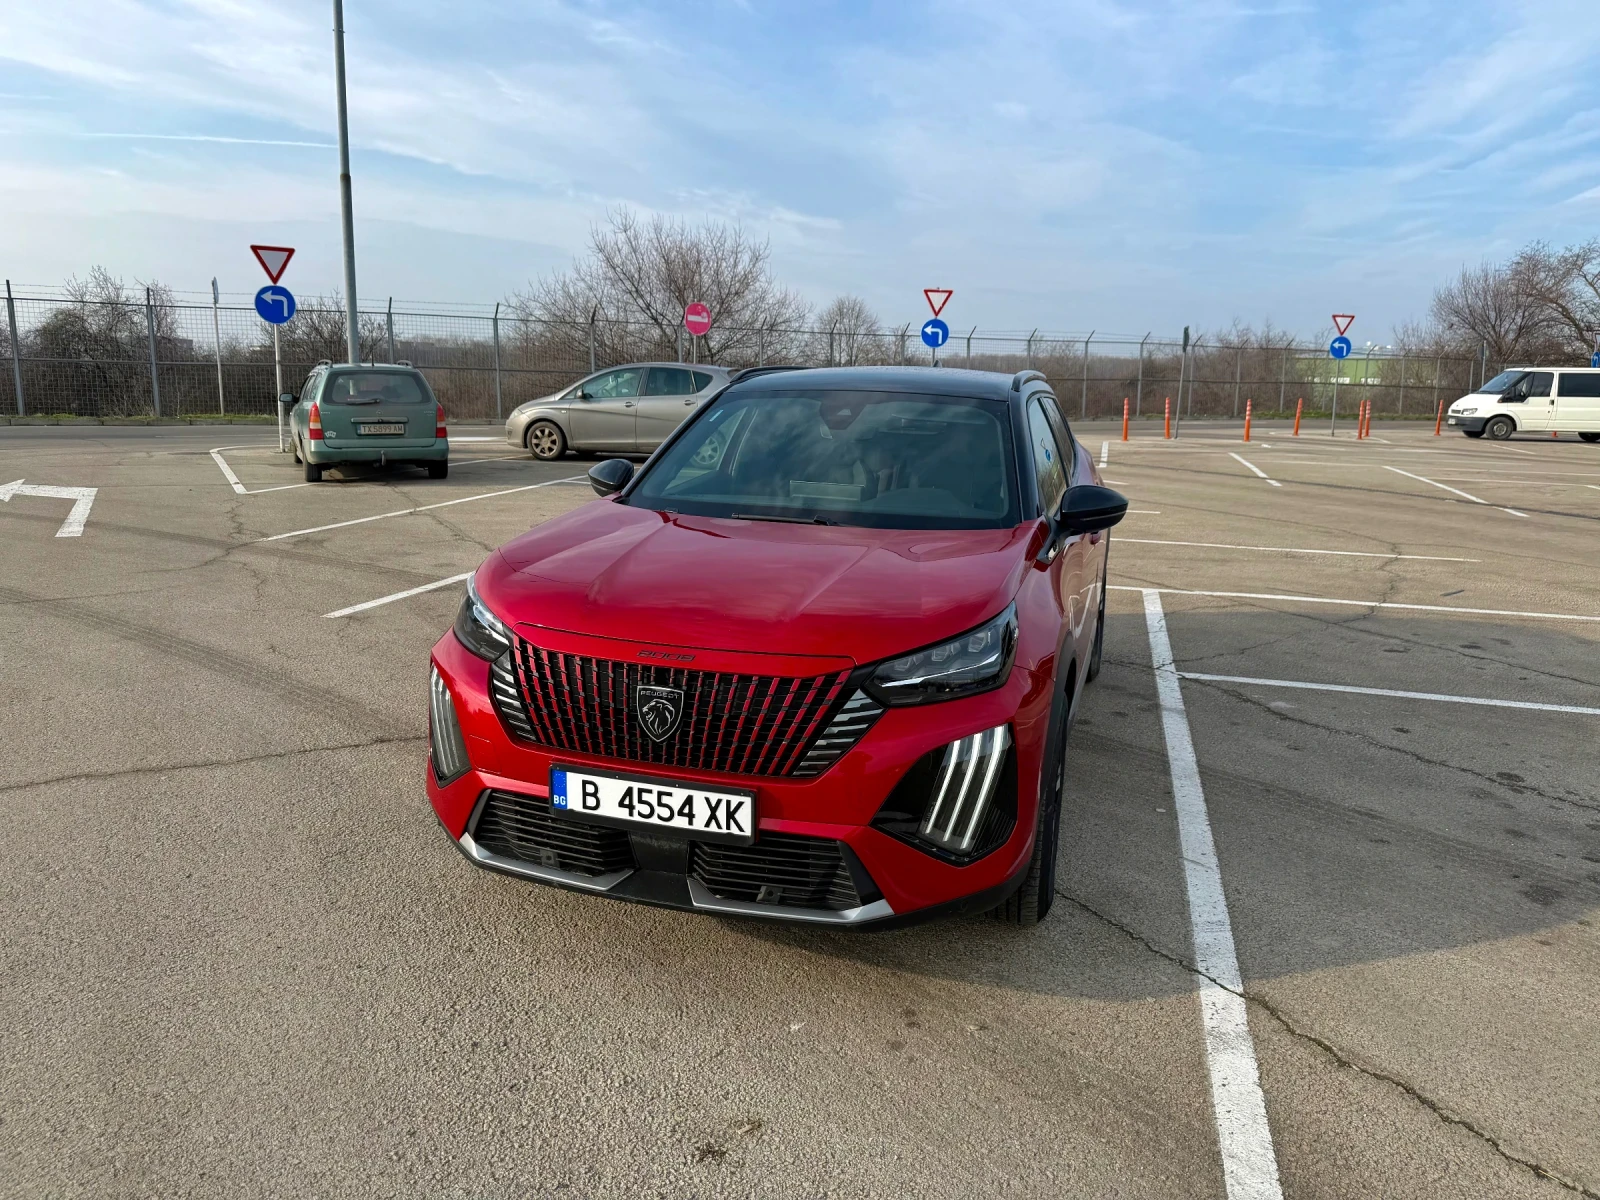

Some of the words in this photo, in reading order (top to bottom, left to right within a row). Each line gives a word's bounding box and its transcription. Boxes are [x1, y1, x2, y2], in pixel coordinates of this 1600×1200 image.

[637, 649, 696, 662] 2008
[640, 690, 680, 699] PEUGEOT
[553, 795, 566, 805] BG
[581, 779, 601, 811] B
[617, 786, 696, 826] 4554
[704, 796, 746, 833] XK
